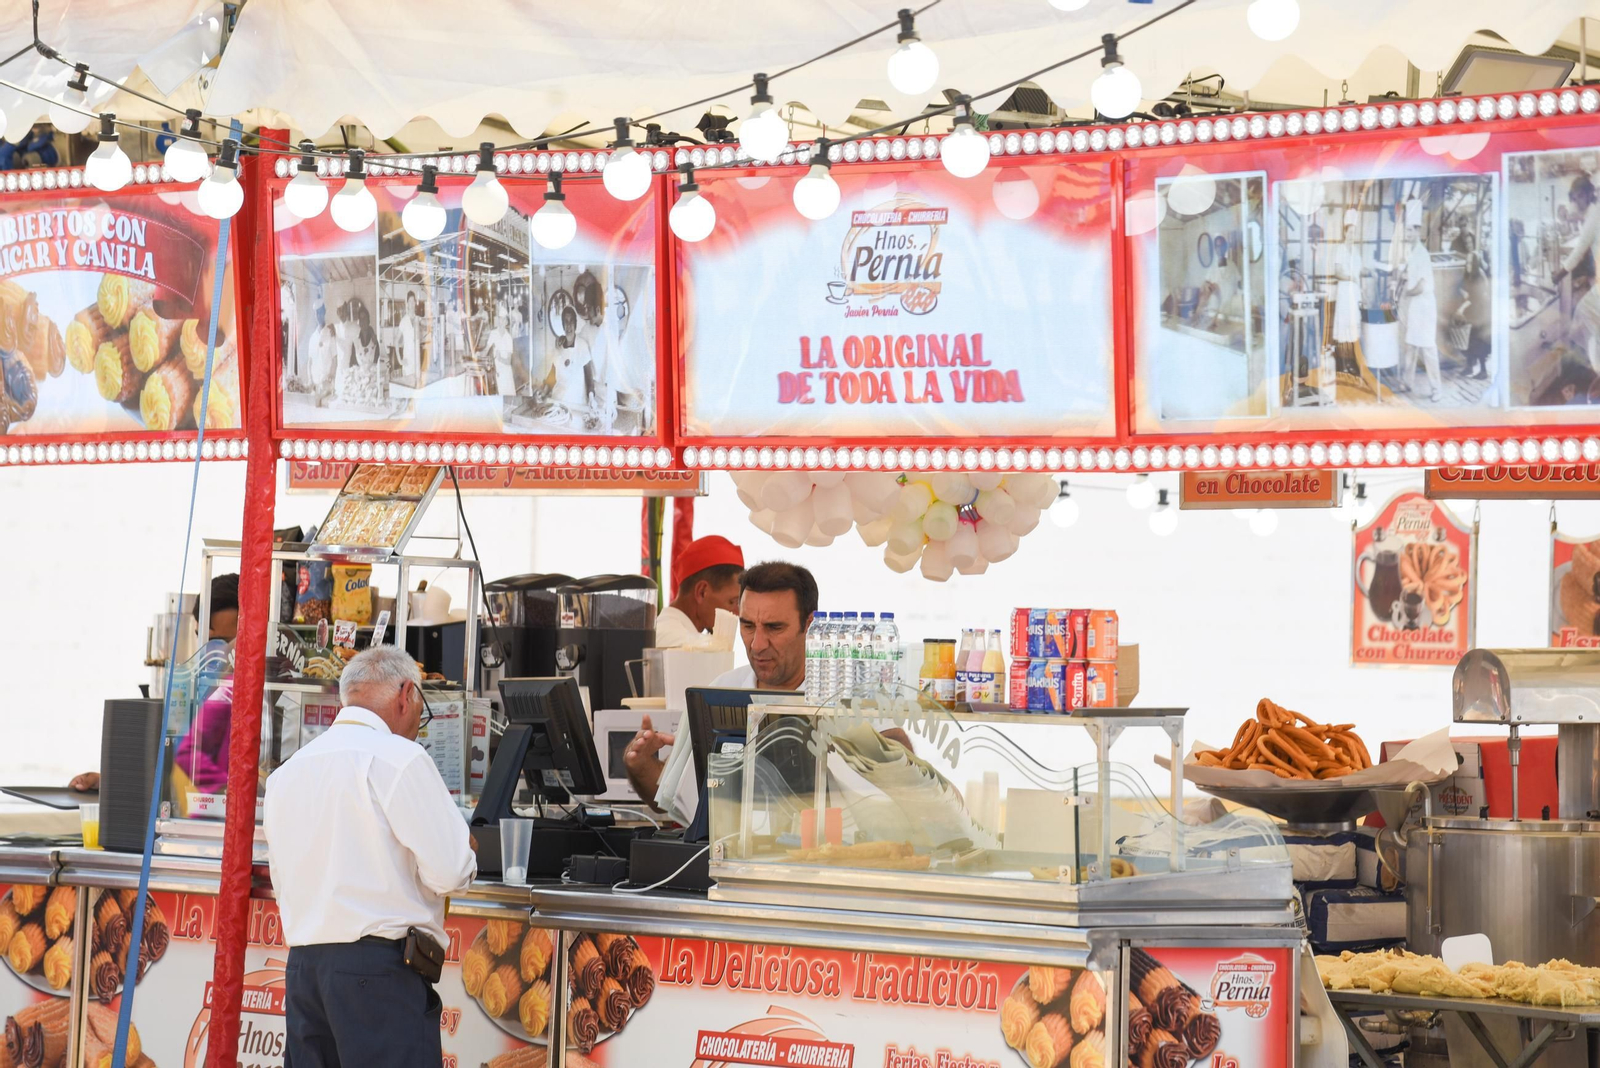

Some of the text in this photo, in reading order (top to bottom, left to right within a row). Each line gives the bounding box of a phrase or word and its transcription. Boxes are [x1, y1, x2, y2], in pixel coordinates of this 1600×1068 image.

[101, 213, 147, 247] CON
[874, 230, 917, 250] Hnos.
[55, 239, 69, 266] Y
[73, 240, 156, 279] CANELA
[850, 243, 943, 282] Pernía
[799, 333, 992, 369] LA ORIGINAL
[777, 369, 1026, 404] DE TODA LA VIDA
[1196, 472, 1320, 494] en Chocolate
[1367, 625, 1454, 643] Chocolate
[1356, 644, 1464, 661] con Churros
[173, 893, 203, 940] La
[659, 937, 998, 1010] La Deliciosa Tradición
[1216, 980, 1271, 1000] Pernía
[1231, 973, 1254, 985] Hnos.
[699, 1035, 777, 1061] CHOCOLATERÍA
[787, 1043, 851, 1068] CHURRERÍA
